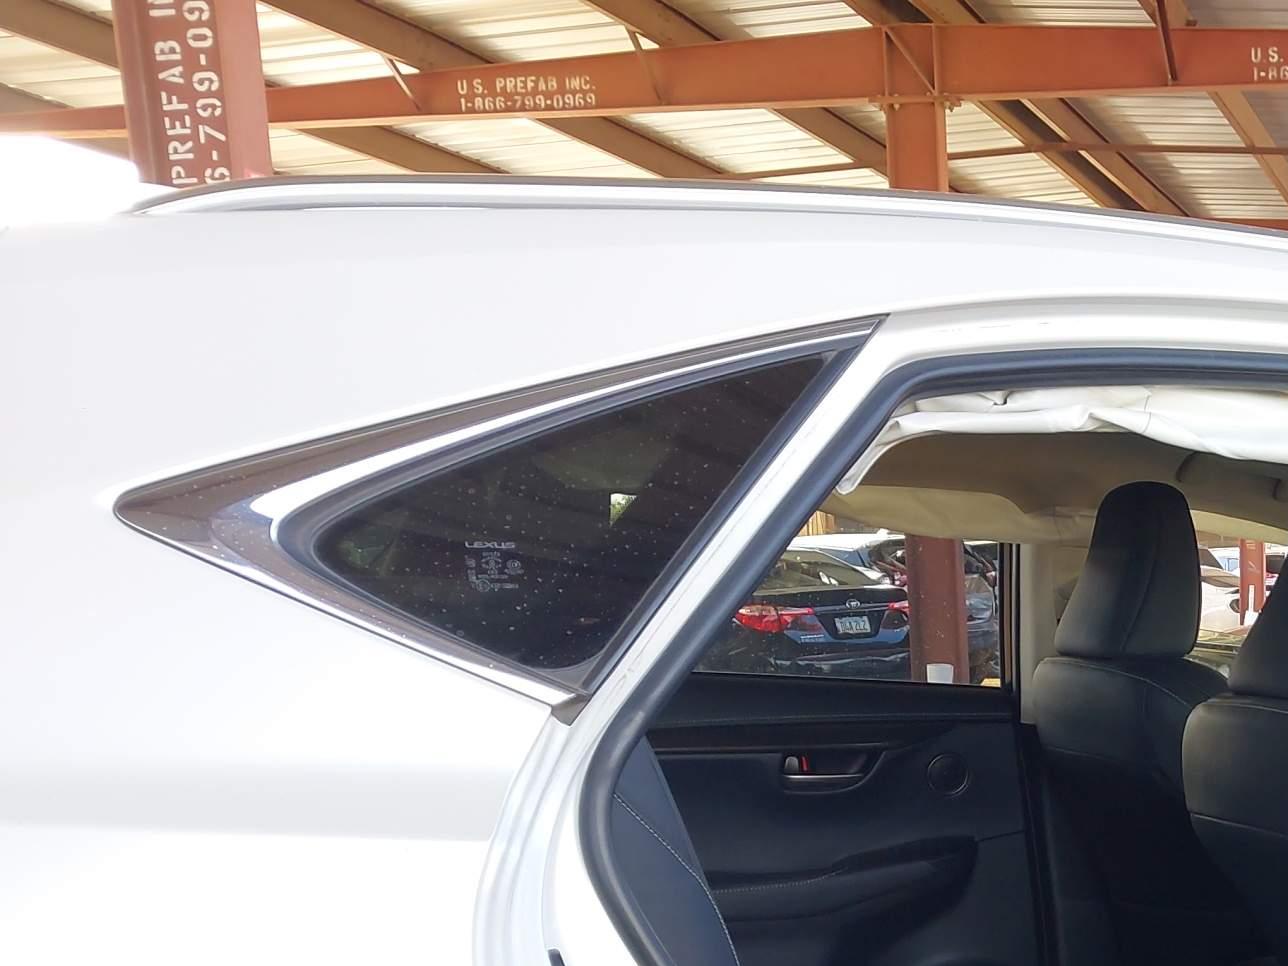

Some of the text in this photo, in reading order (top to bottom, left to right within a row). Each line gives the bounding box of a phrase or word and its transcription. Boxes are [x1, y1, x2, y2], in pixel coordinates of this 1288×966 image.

[147, 0, 198, 184] PREFAB I
[457, 75, 597, 95] US. PREFAB INC.
[460, 92, 597, 113] 1-866-799-0969
[464, 541, 516, 549] LEXUS
